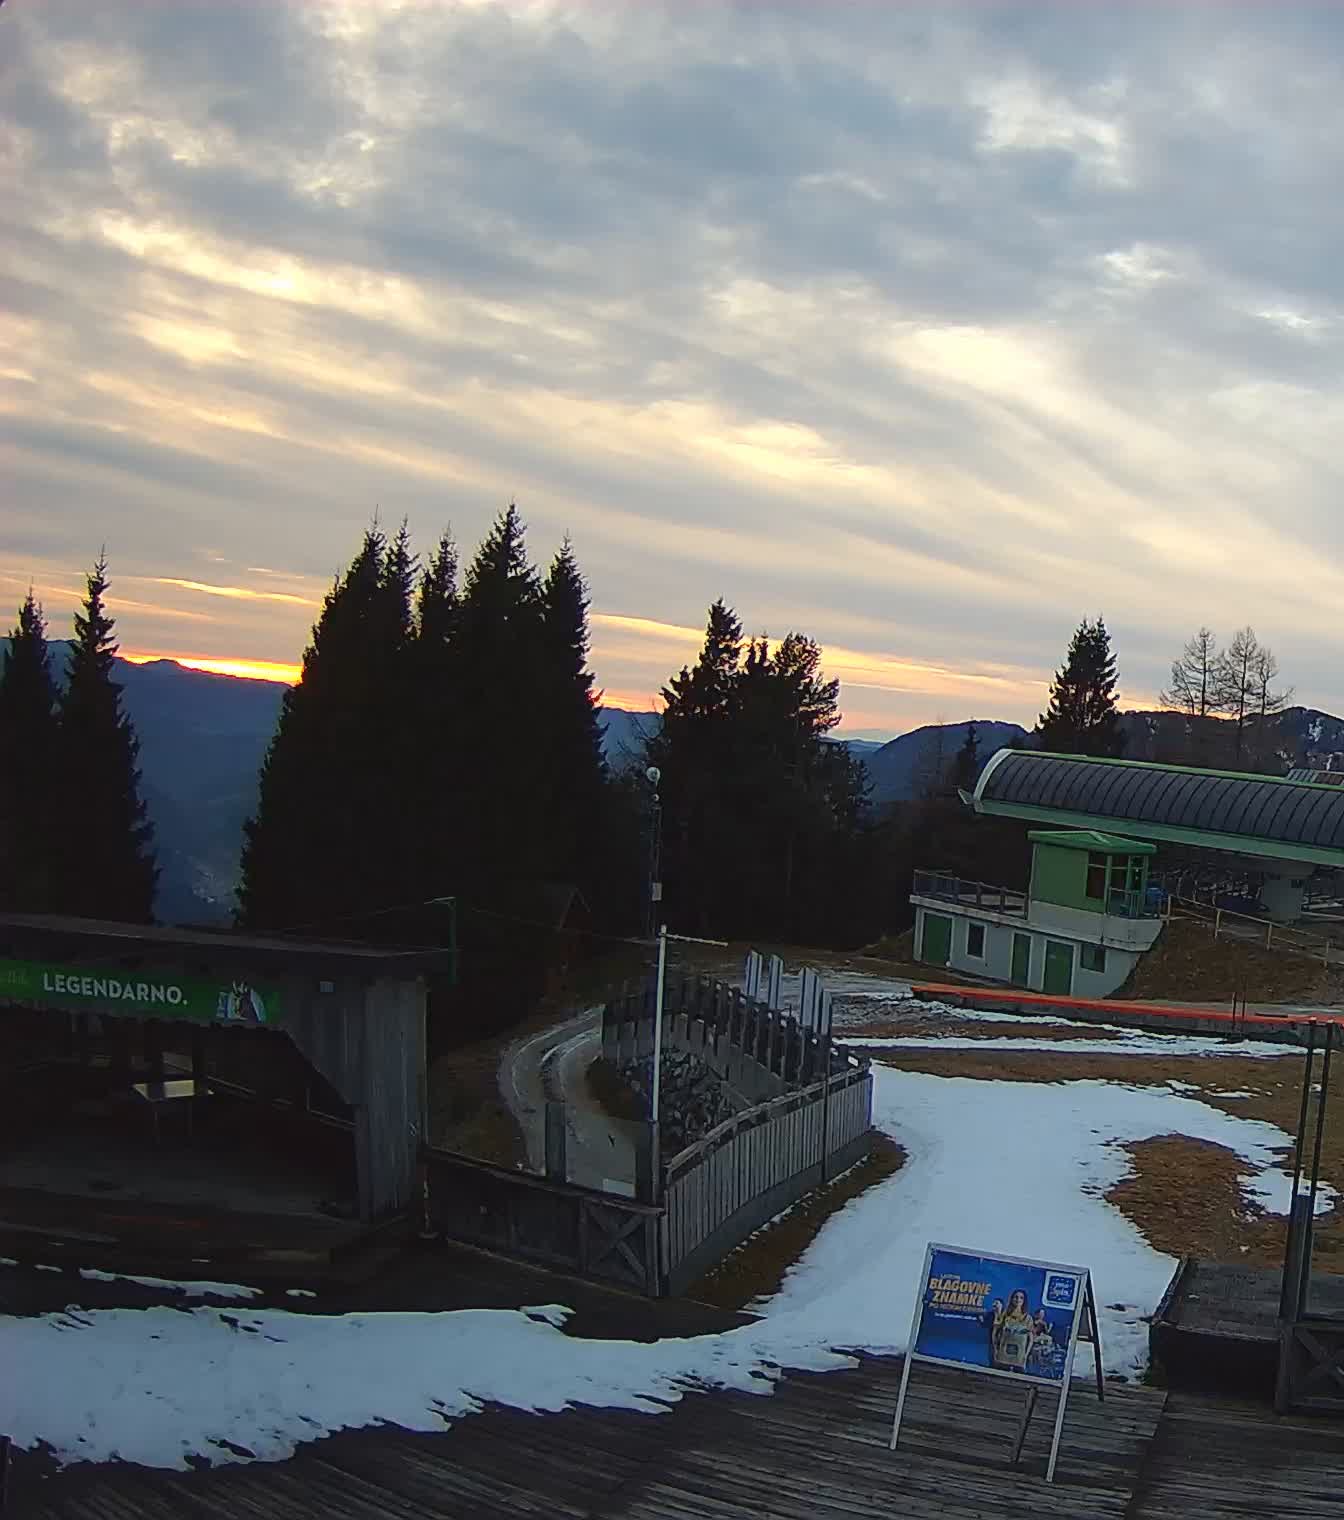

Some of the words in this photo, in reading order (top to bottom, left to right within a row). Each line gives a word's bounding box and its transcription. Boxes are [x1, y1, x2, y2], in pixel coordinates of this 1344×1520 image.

[43, 973, 188, 1006] LEGENDARNO.
[929, 1278, 992, 1295] BLAGOVNE
[932, 1290, 985, 1306] ZNAMKE
